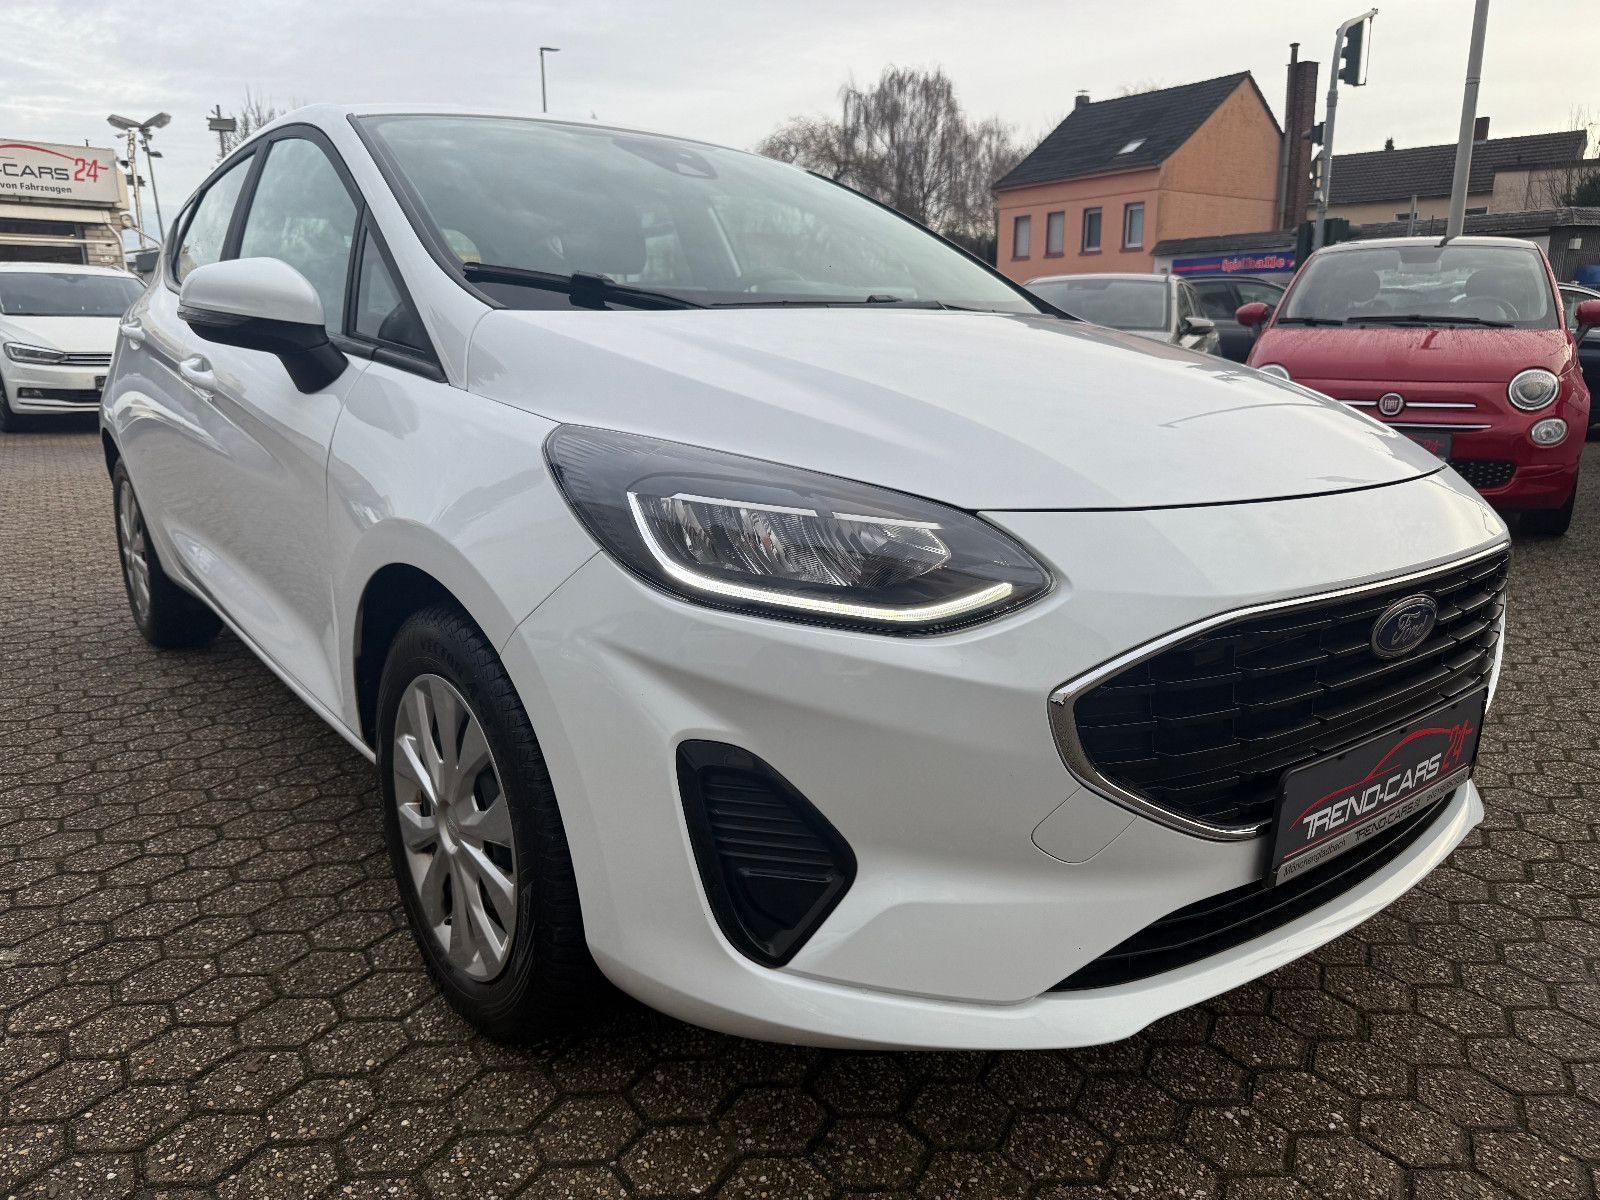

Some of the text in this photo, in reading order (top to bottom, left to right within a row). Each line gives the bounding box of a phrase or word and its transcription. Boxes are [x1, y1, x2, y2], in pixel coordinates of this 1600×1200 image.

[20, 182, 72, 194] Fahrzeugen
[1391, 611, 1428, 645] Ford
[1303, 752, 1442, 840] TREND-CARS
